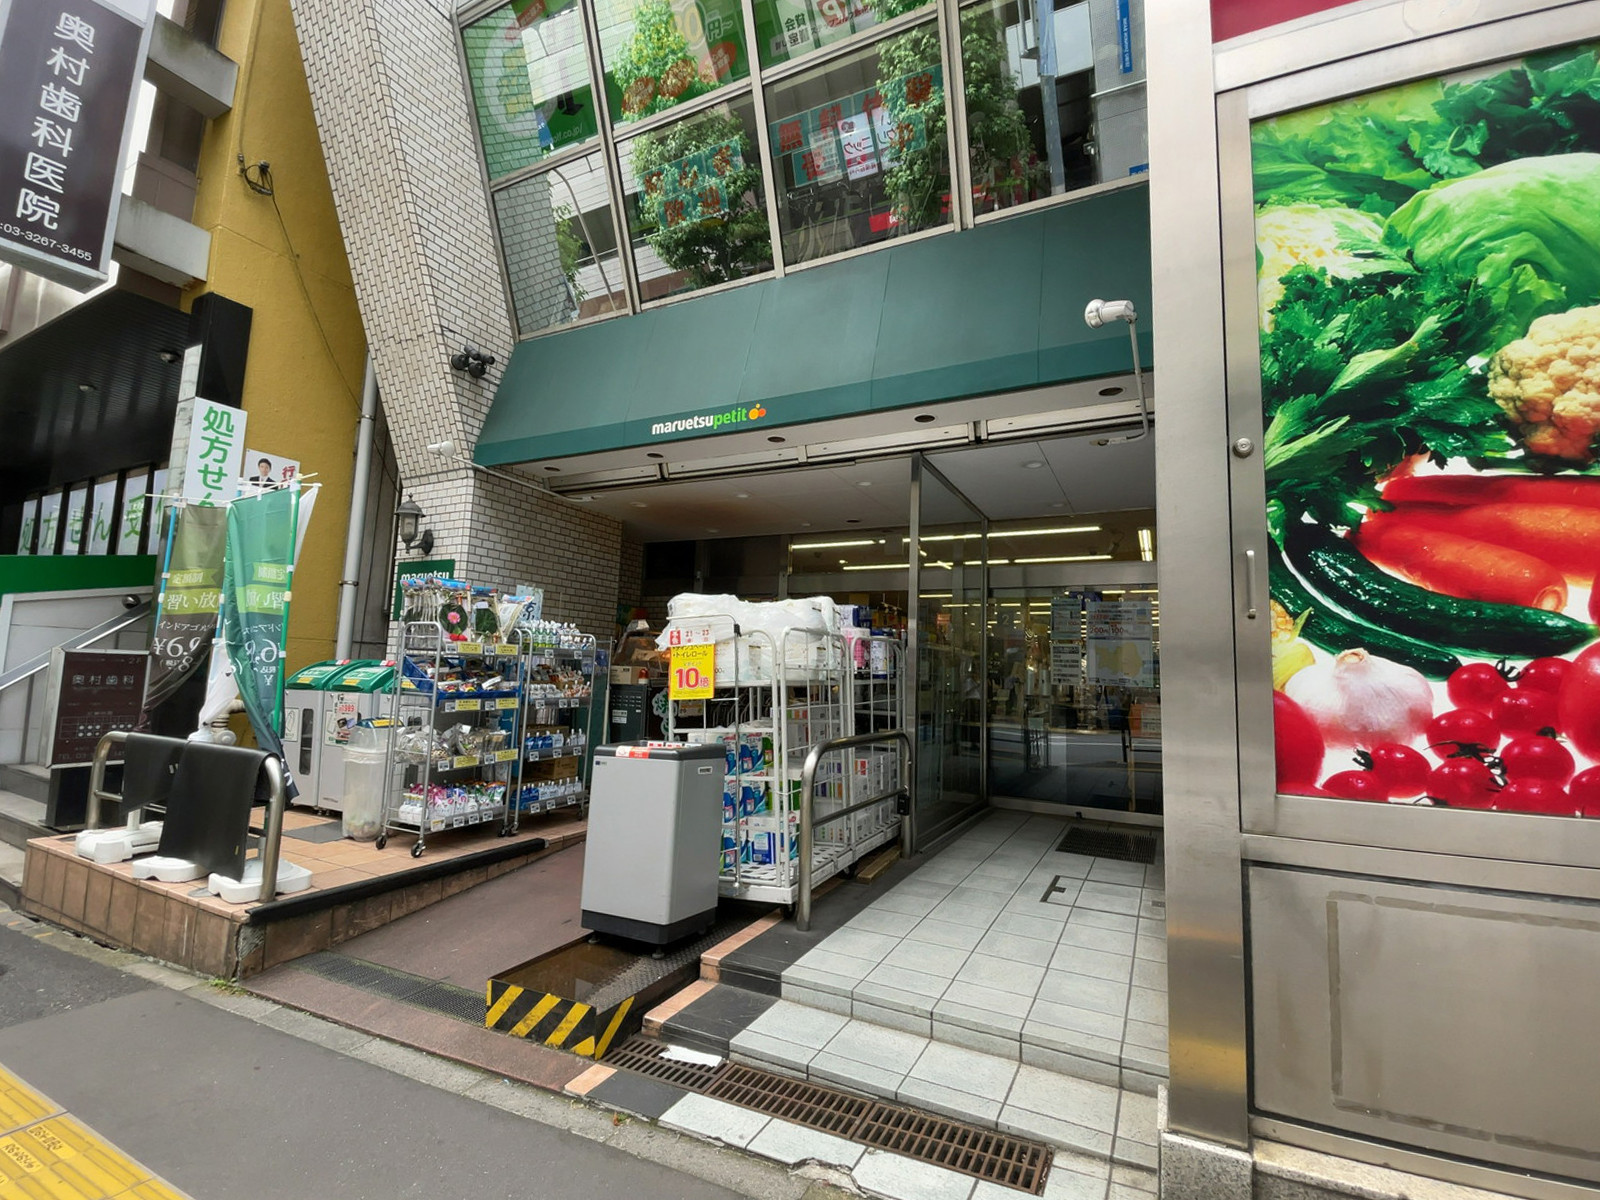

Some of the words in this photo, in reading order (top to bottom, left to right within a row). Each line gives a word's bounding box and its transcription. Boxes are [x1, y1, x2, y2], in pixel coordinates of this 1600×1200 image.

[15, 11, 96, 231] 奥村歯科医院
